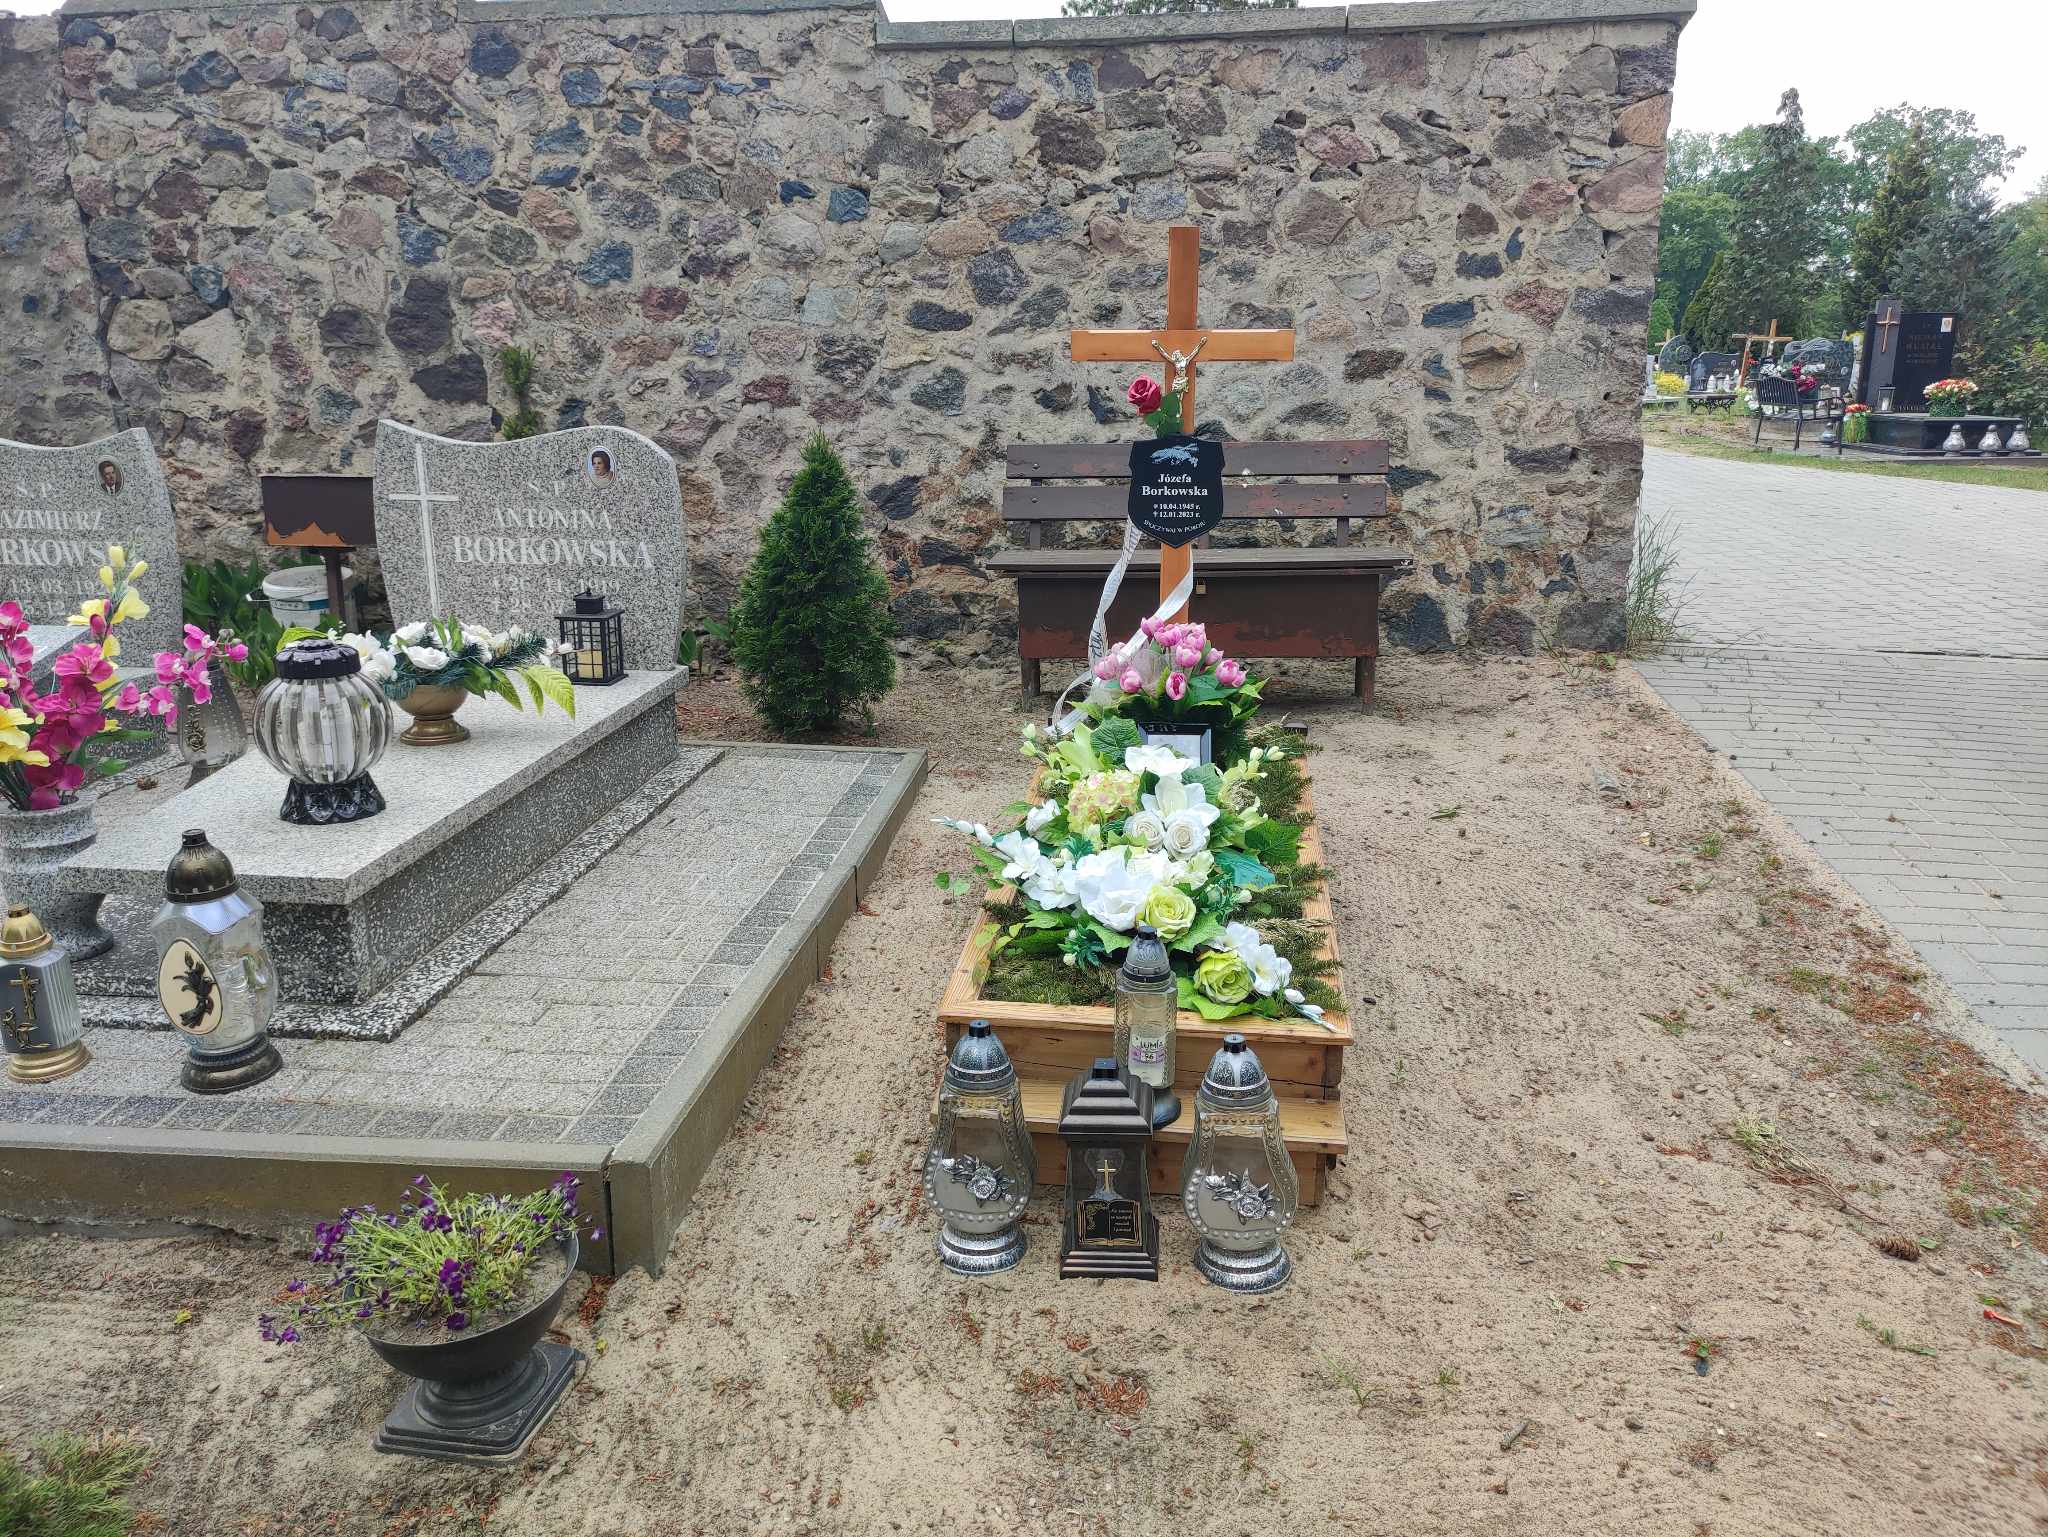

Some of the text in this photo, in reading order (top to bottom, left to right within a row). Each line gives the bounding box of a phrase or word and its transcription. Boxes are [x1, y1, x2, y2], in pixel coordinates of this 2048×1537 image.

[1158, 473, 1192, 484] Józefa
[1141, 485, 1209, 497] Borkowska
[0, 509, 105, 531] AZIMIERZ
[494, 506, 613, 531] ANTONINA
[453, 534, 655, 569] BORKOWSKA
